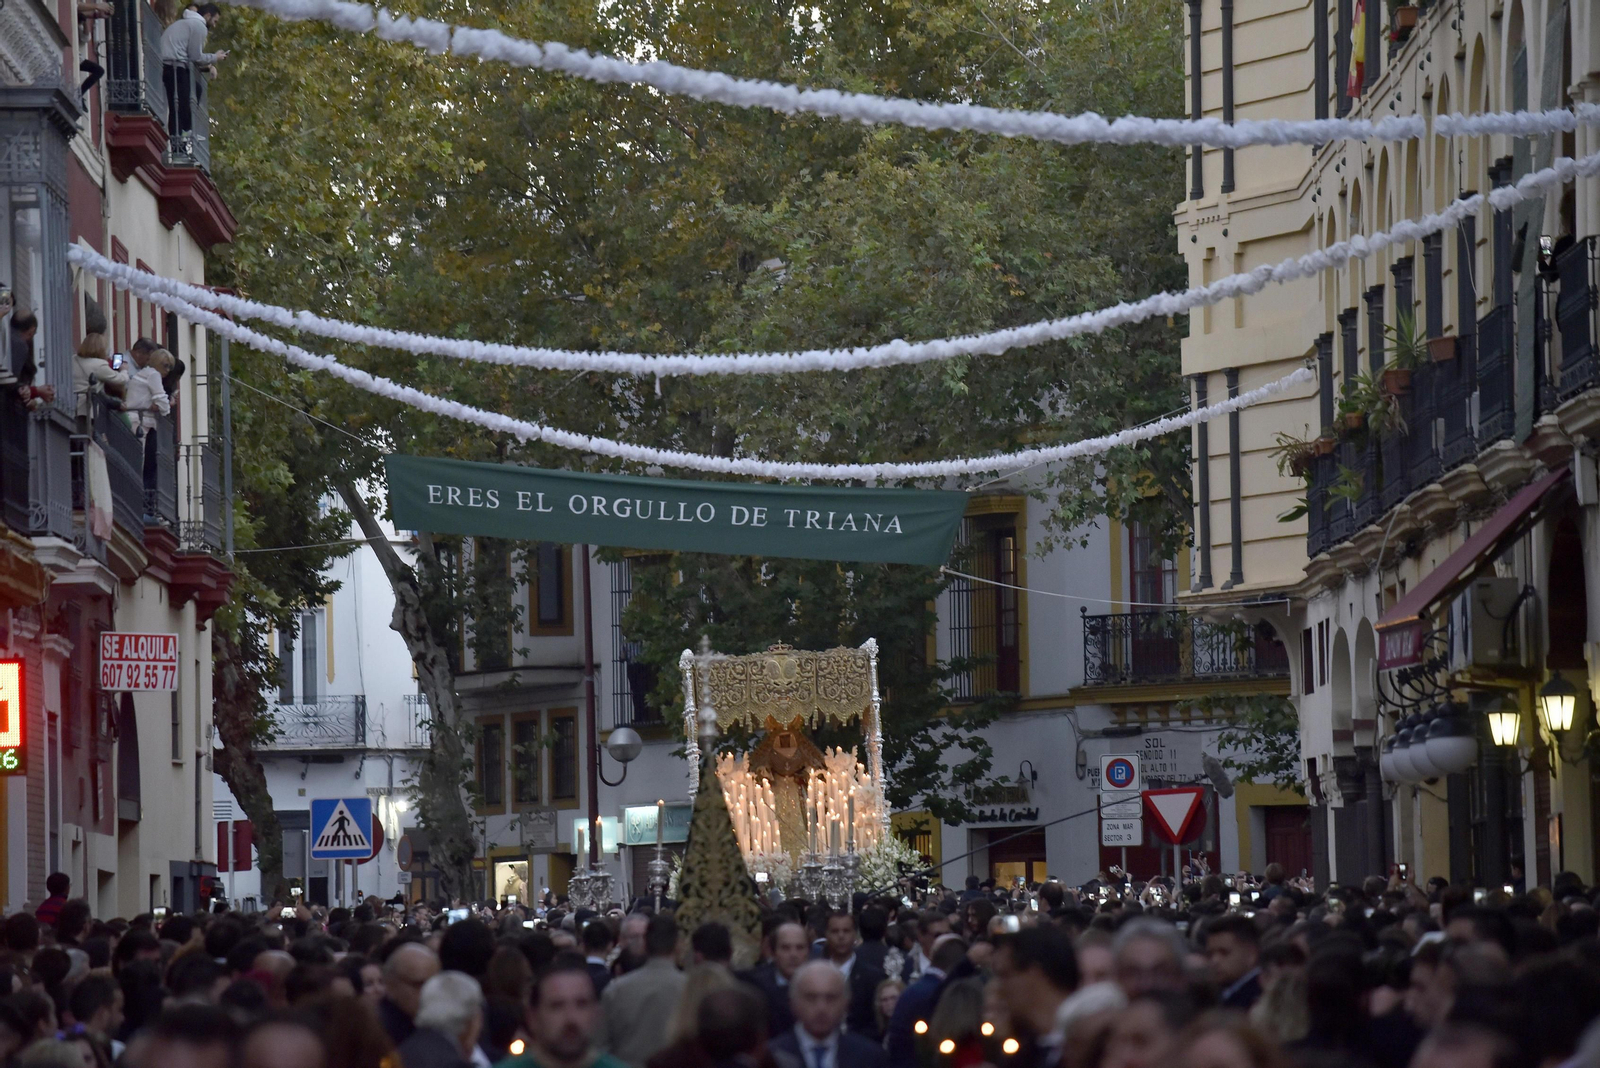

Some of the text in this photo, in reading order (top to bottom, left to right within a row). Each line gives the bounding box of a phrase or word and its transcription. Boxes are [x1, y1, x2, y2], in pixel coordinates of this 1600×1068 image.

[427, 484, 903, 534] ERES EL ORGULLO DE TRIANA
[103, 635, 176, 661] SE ALQUILA
[102, 663, 176, 690] 607 92 55 77
[1145, 737, 1166, 749] SOL
[1150, 763, 1167, 773] ALTO
[1106, 823, 1120, 831] ZONA
[1104, 833, 1132, 842] SECTOR 3
